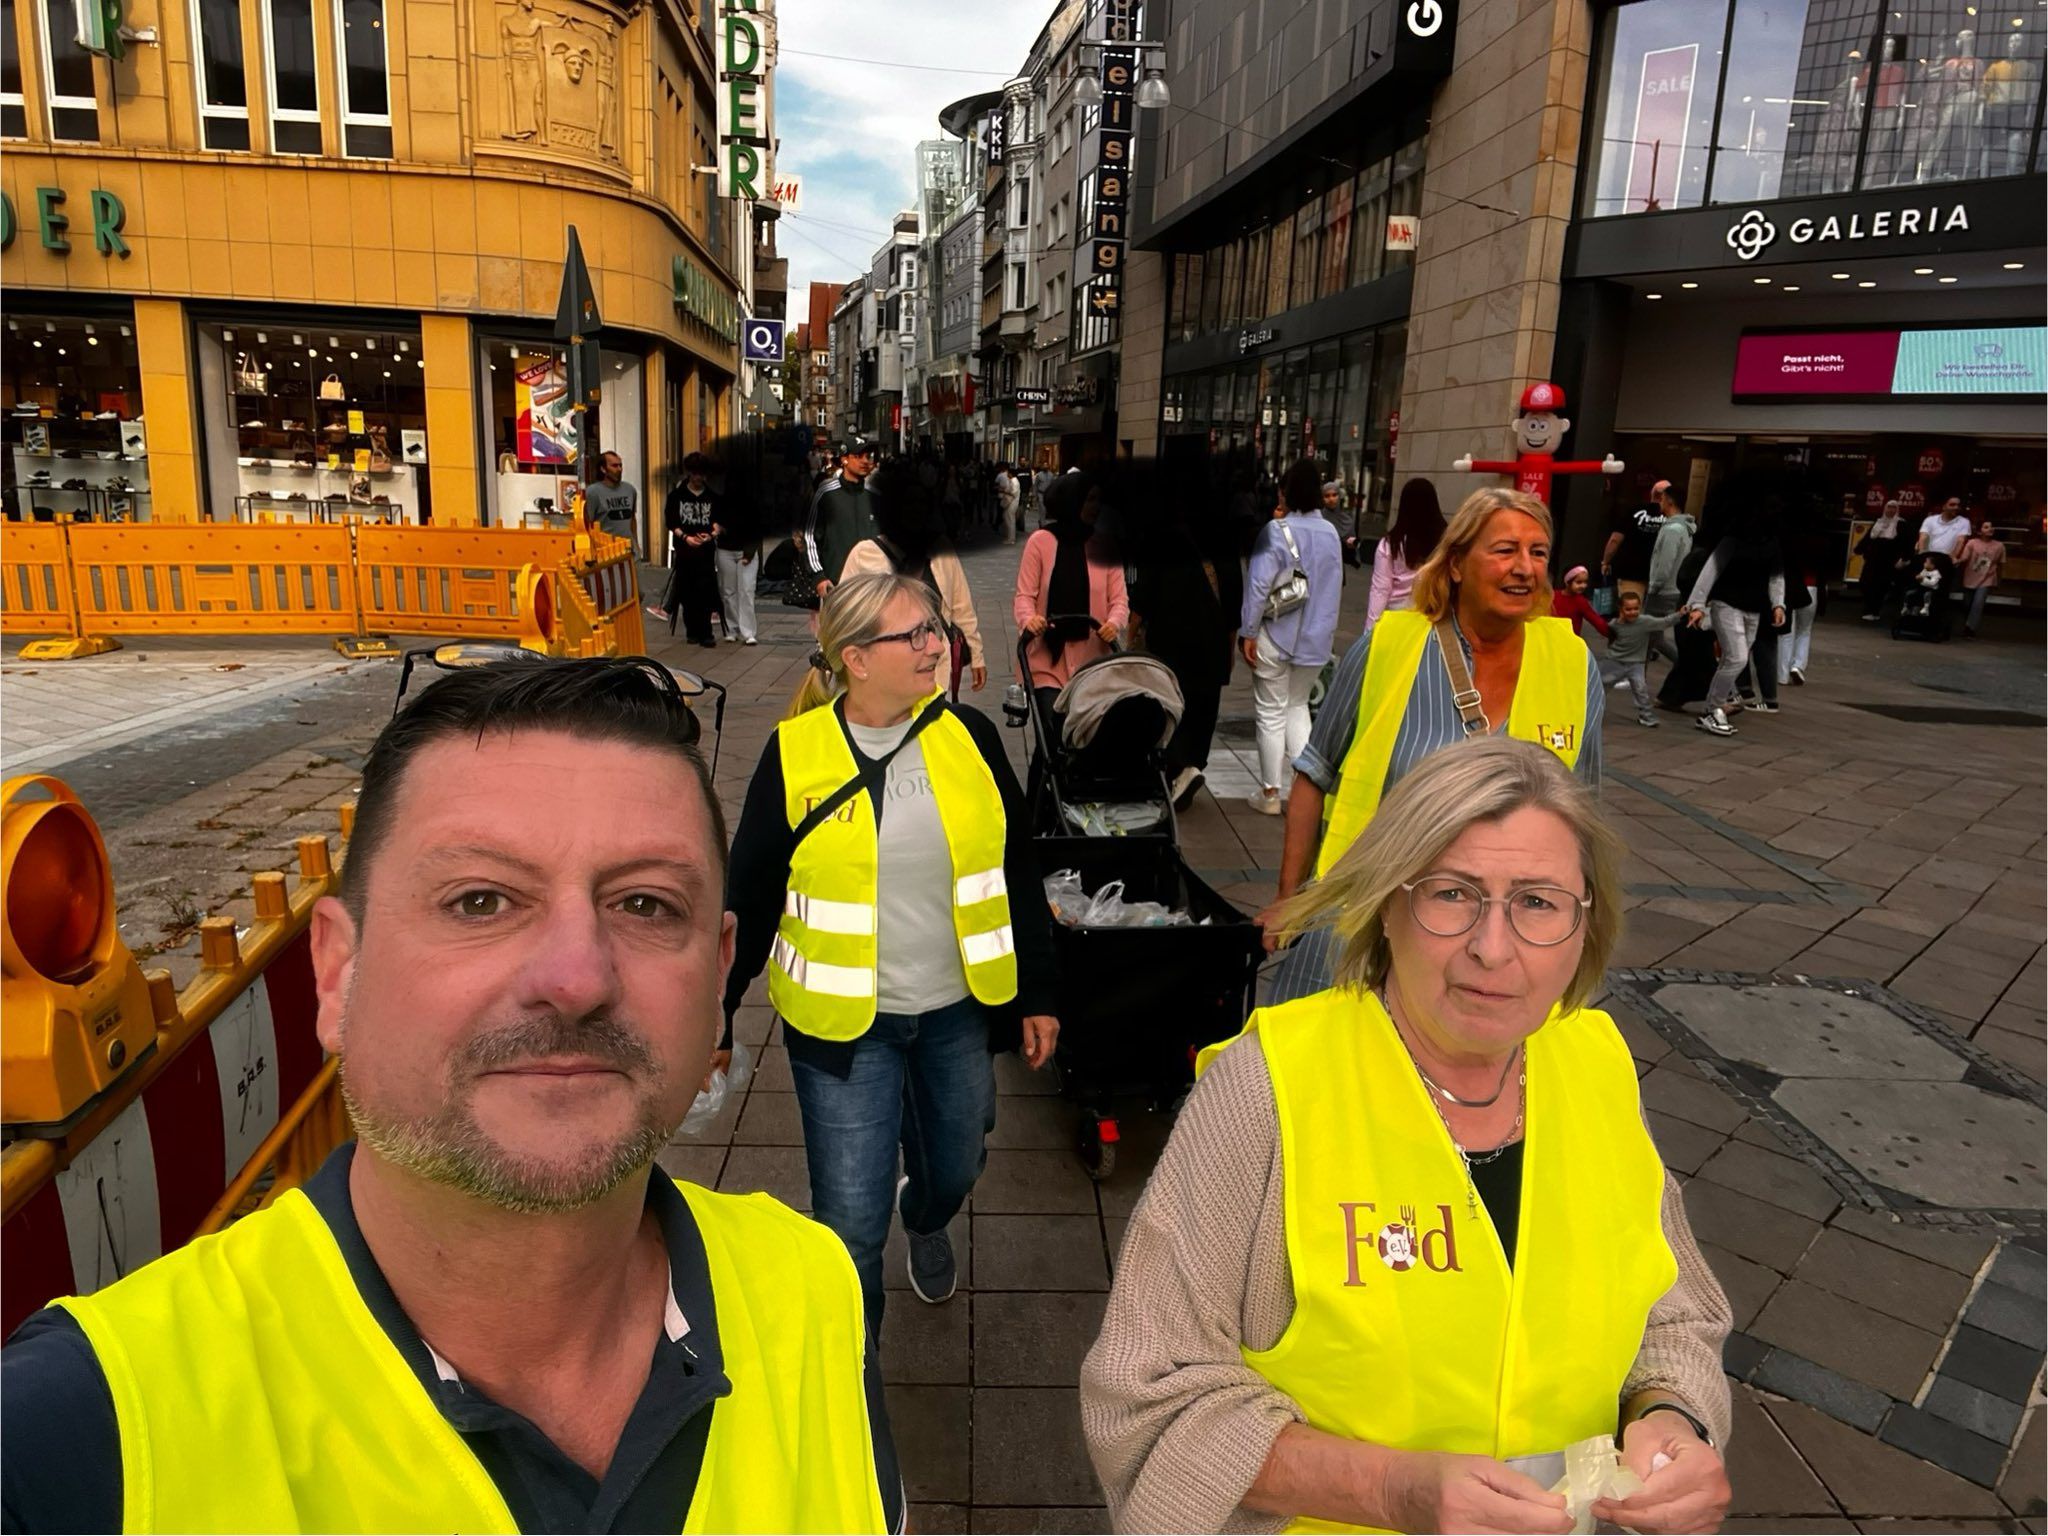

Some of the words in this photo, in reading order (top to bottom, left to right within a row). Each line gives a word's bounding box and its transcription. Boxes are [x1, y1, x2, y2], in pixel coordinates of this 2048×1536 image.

[1645, 75, 1690, 96] SALE
[725, 0, 759, 201] DER
[991, 115, 1003, 160] KKH
[1789, 204, 1969, 243] GALERIA
[1783, 355, 1812, 363] Passt
[1814, 354, 1844, 363] nicht,
[1781, 365, 1812, 373] Gibt's
[1814, 364, 1844, 372] nicht!
[606, 496, 631, 510] NIKE
[1898, 490, 1913, 500] 70
